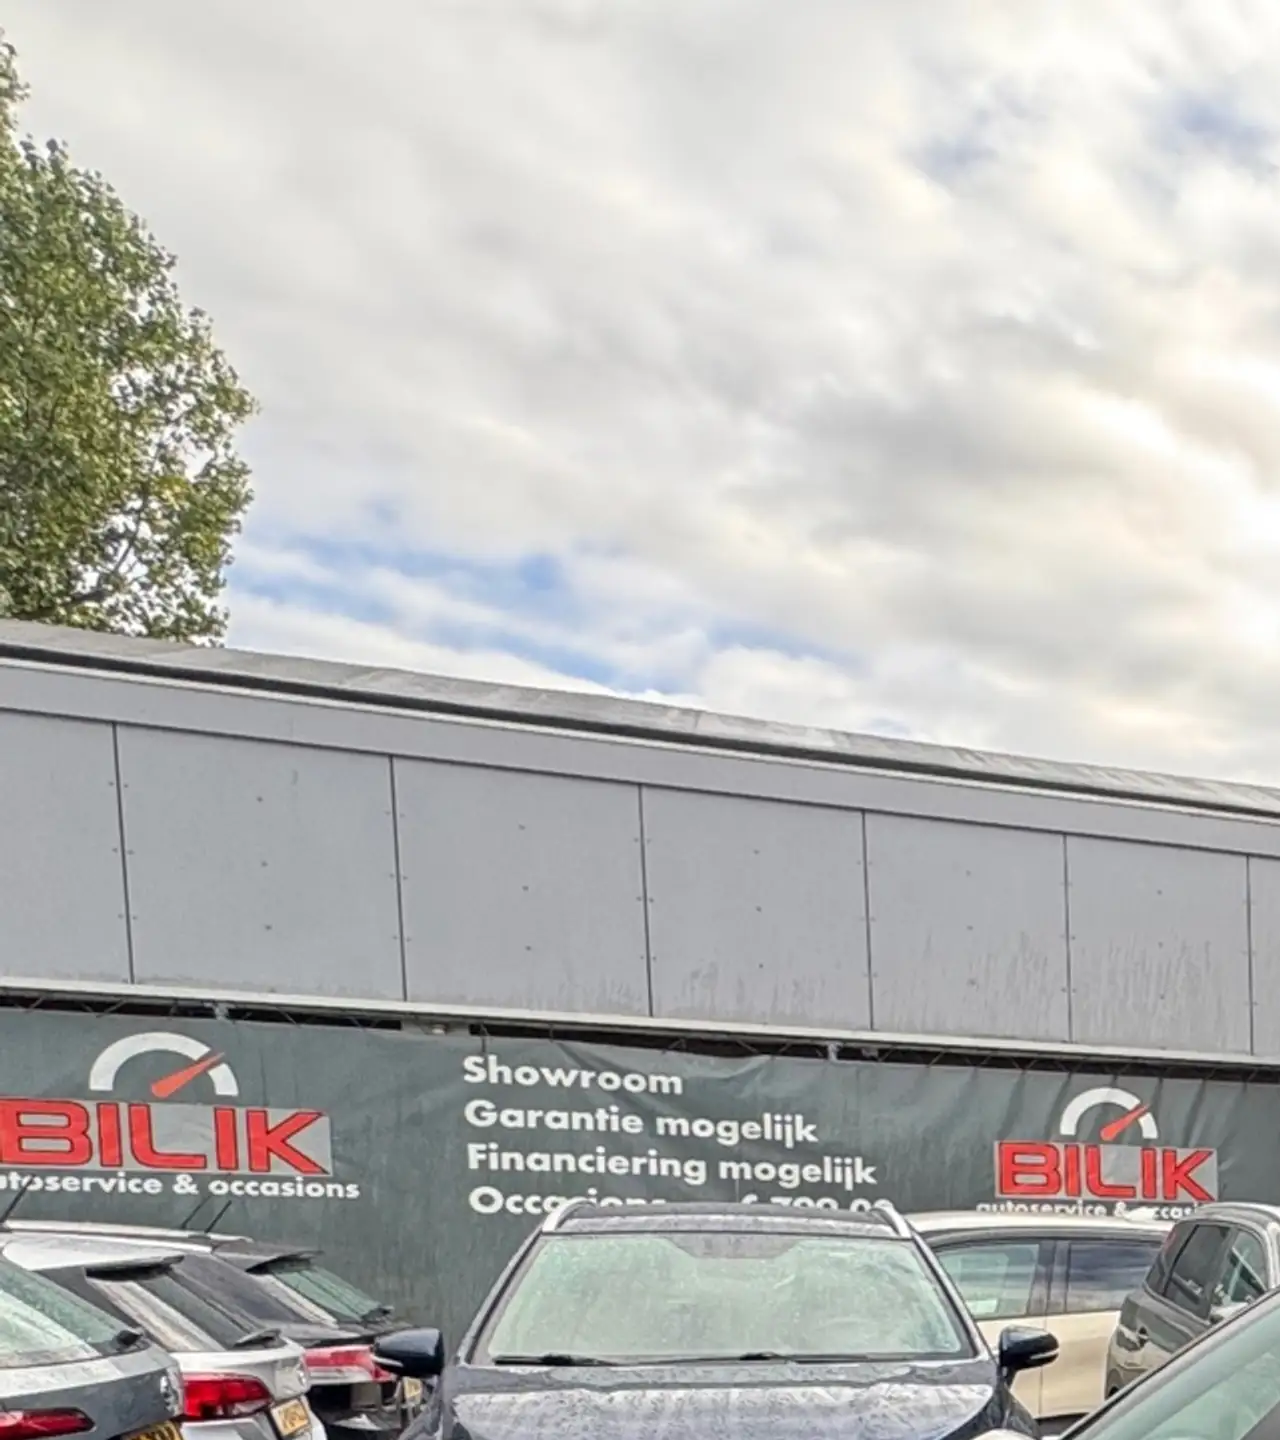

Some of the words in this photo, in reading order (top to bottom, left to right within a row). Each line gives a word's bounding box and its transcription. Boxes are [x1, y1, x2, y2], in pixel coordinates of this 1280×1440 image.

[463, 1055, 684, 1095] Showroom
[464, 1099, 644, 1134] Garantie
[656, 1112, 819, 1148] mogelijk
[172, 1173, 199, 1195] &
[208, 1176, 360, 1199] occasions
[467, 1142, 706, 1185] Financiering
[719, 1156, 877, 1191] mogelijk
[999, 1142, 1216, 1202] BILIK
